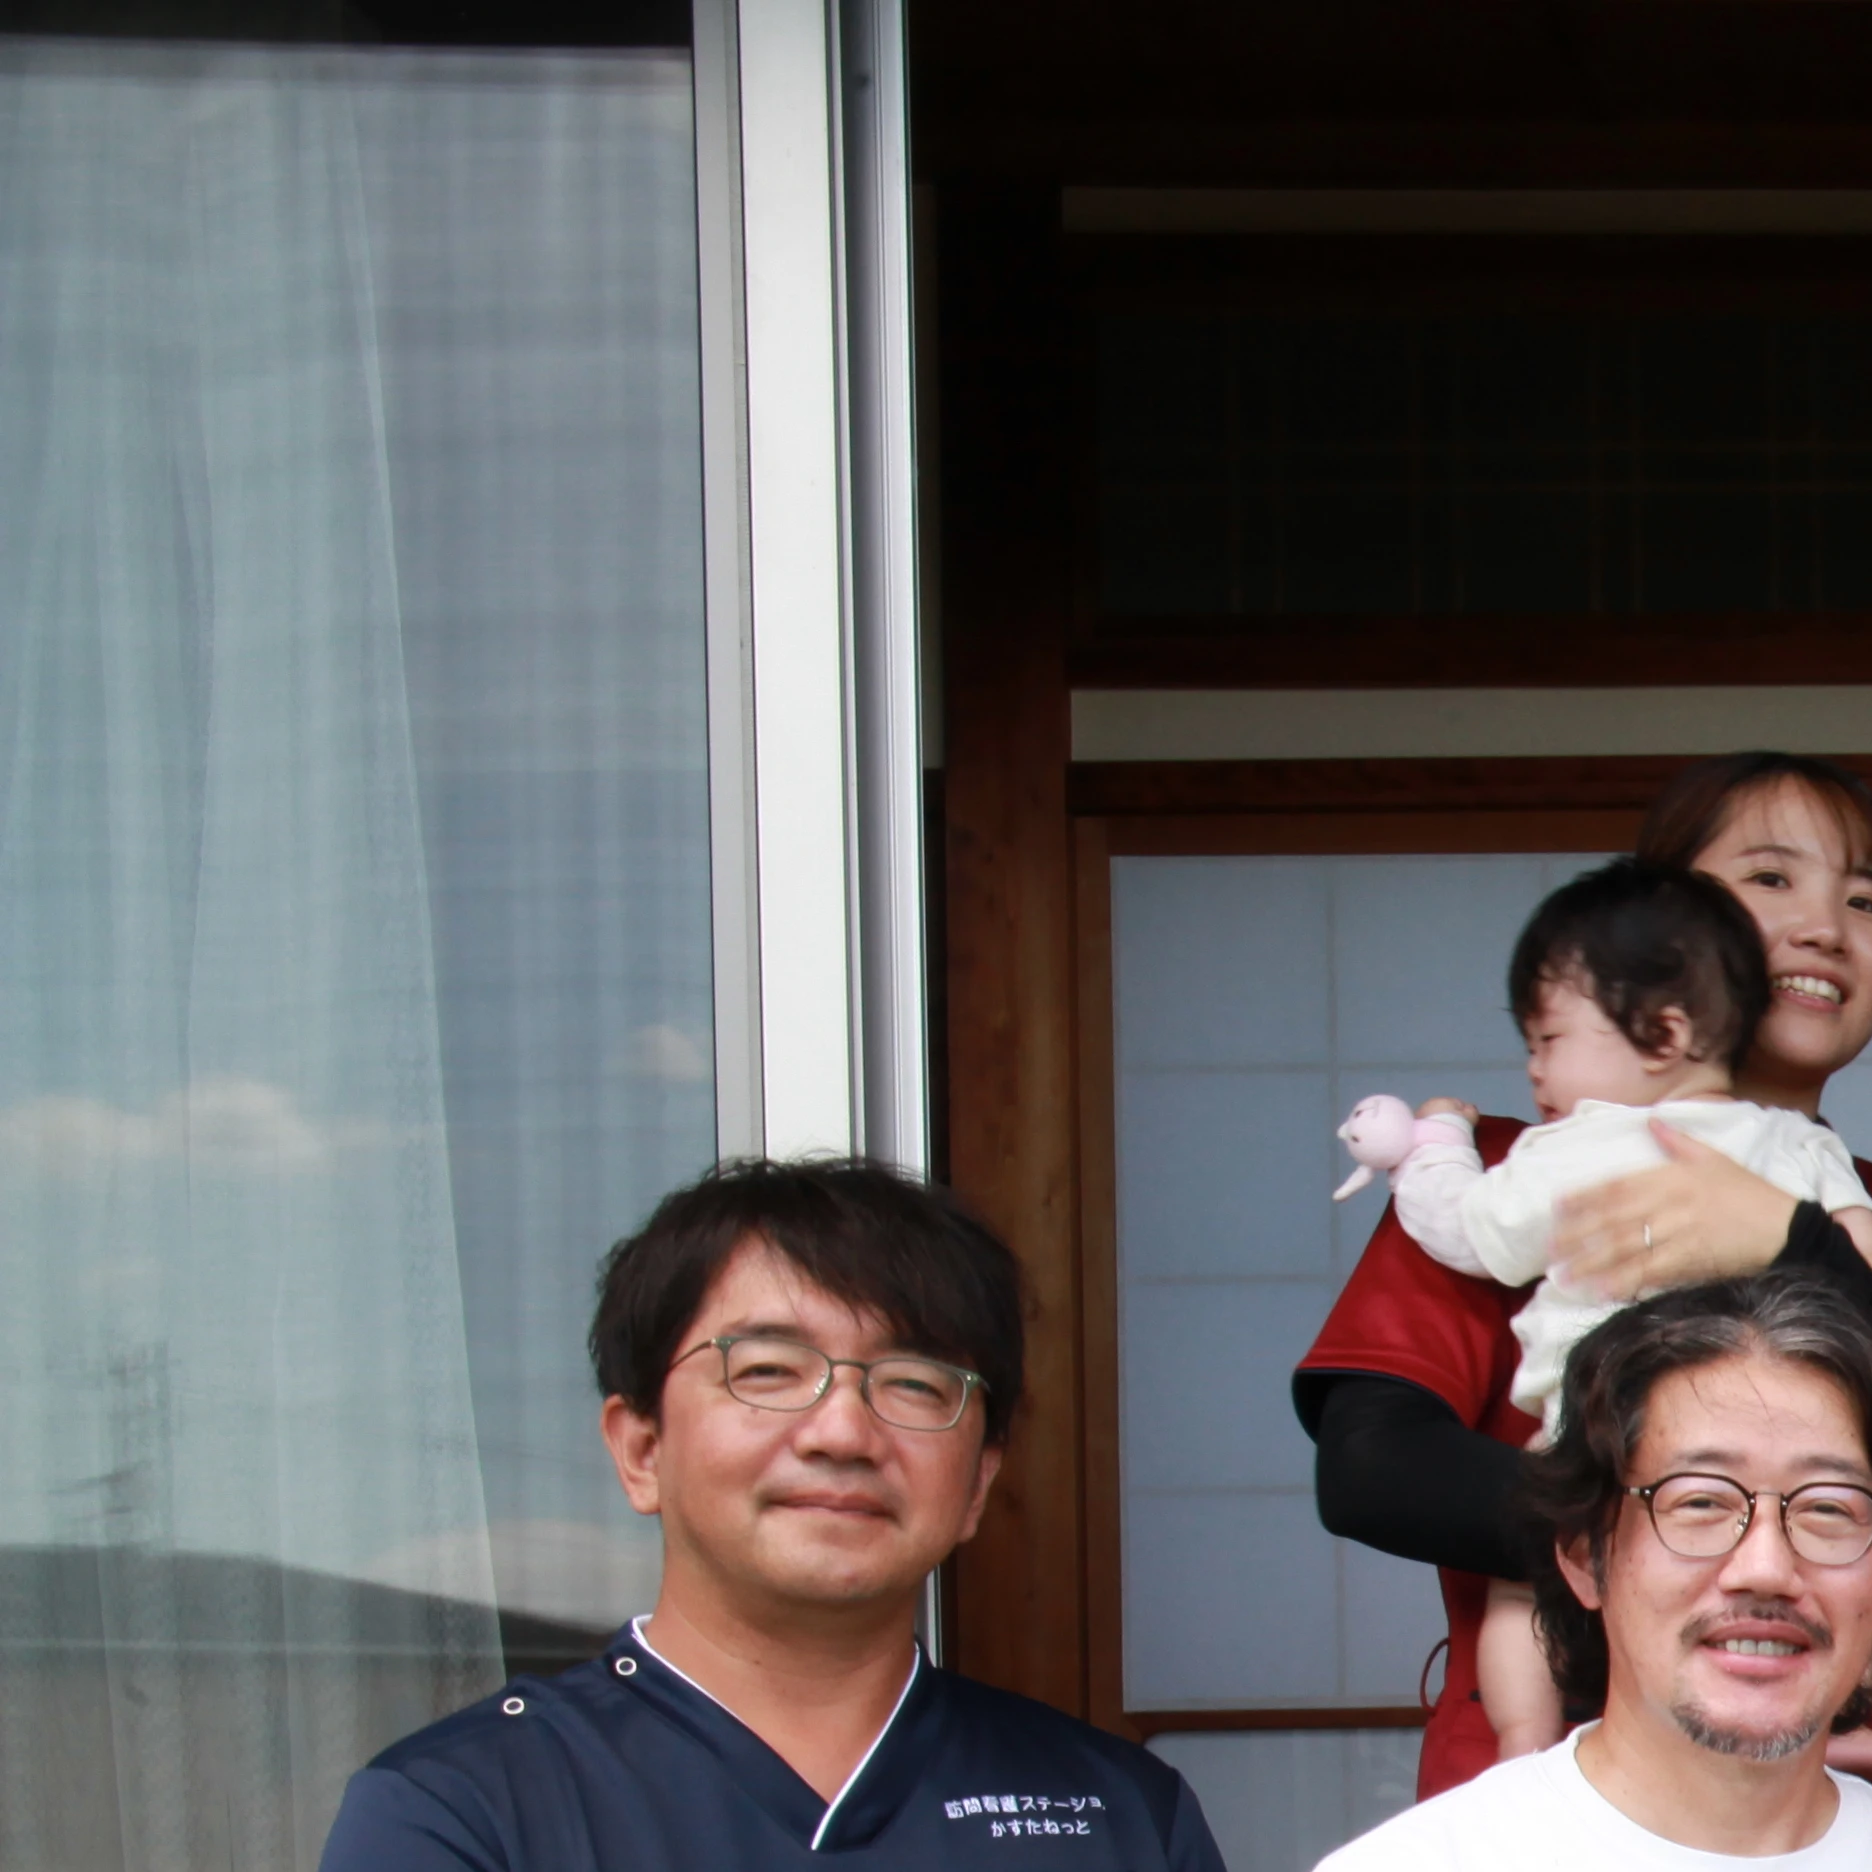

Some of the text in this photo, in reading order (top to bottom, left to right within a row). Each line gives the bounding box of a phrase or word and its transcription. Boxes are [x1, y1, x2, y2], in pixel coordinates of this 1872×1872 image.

[944, 1795, 1106, 1819] 訪問看護ステーショ
[991, 1819, 1090, 1838] かすたねっと
